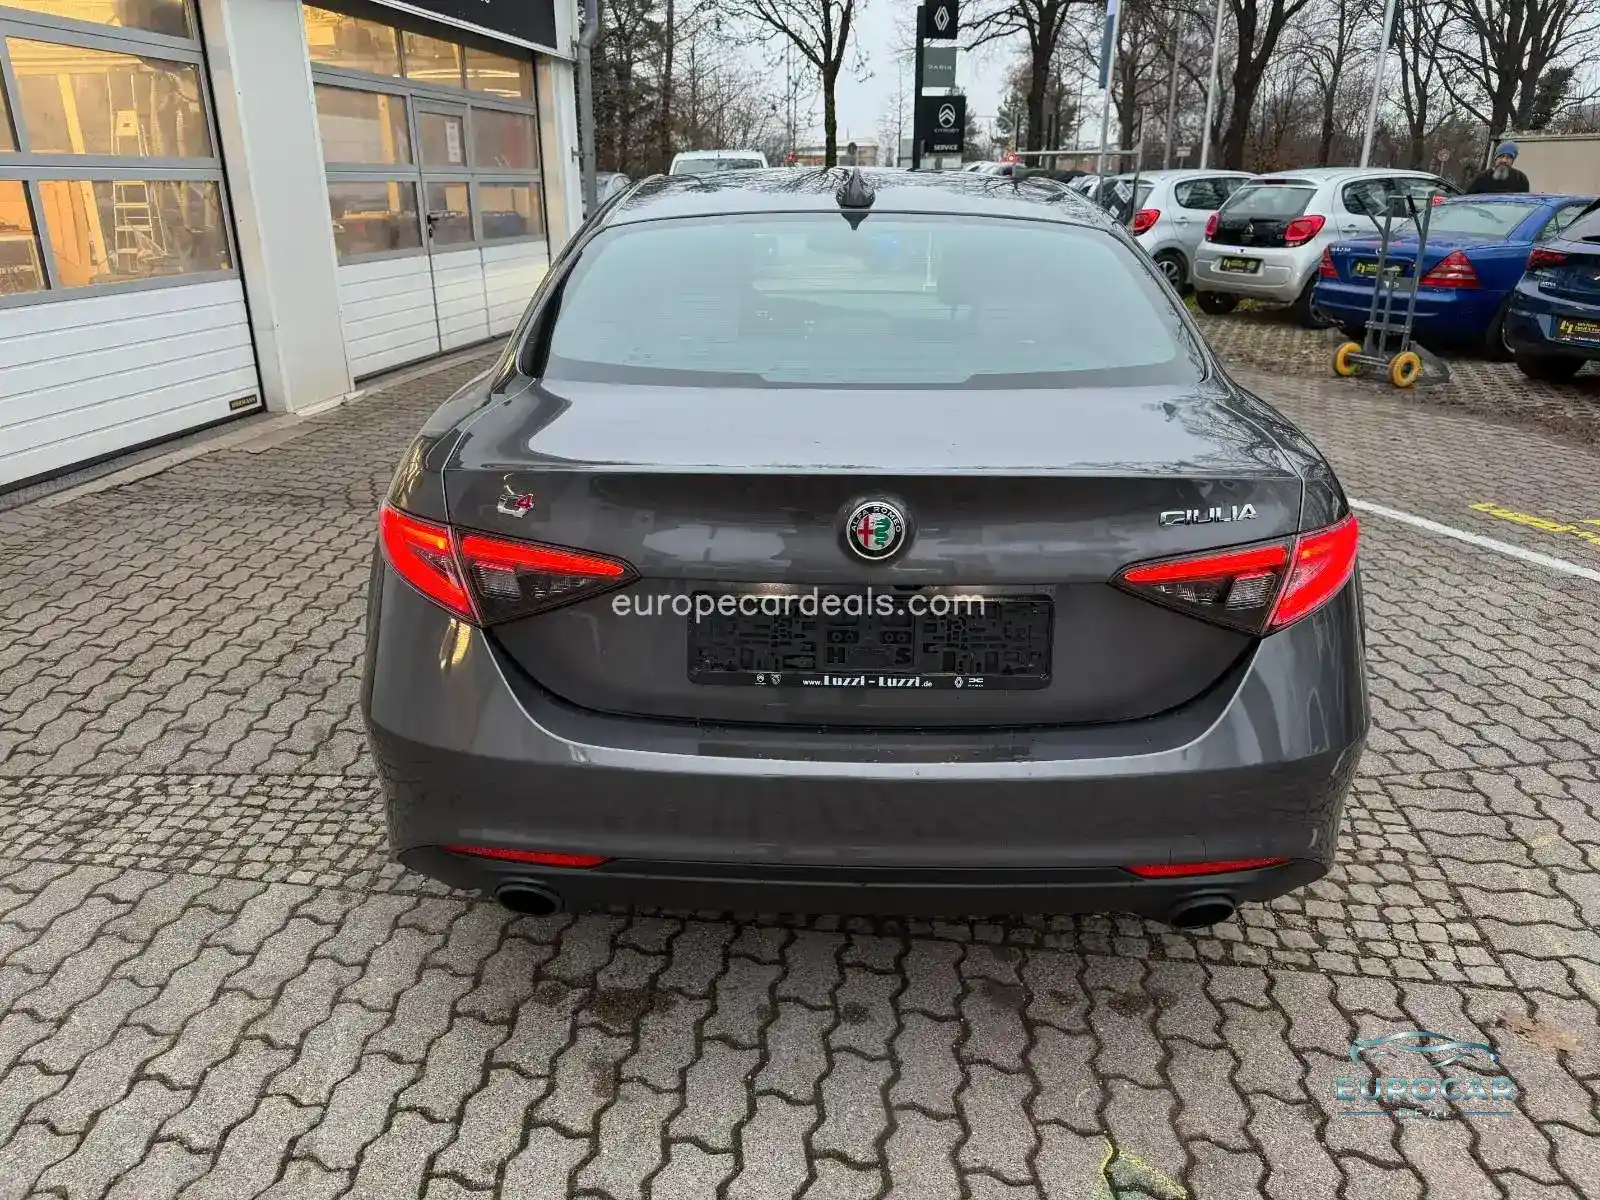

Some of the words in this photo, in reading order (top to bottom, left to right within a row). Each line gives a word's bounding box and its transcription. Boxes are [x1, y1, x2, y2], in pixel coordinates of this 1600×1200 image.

[851, 509, 869, 532] ALFA
[873, 506, 902, 533] ROMEO
[1159, 503, 1257, 526] GIULIA
